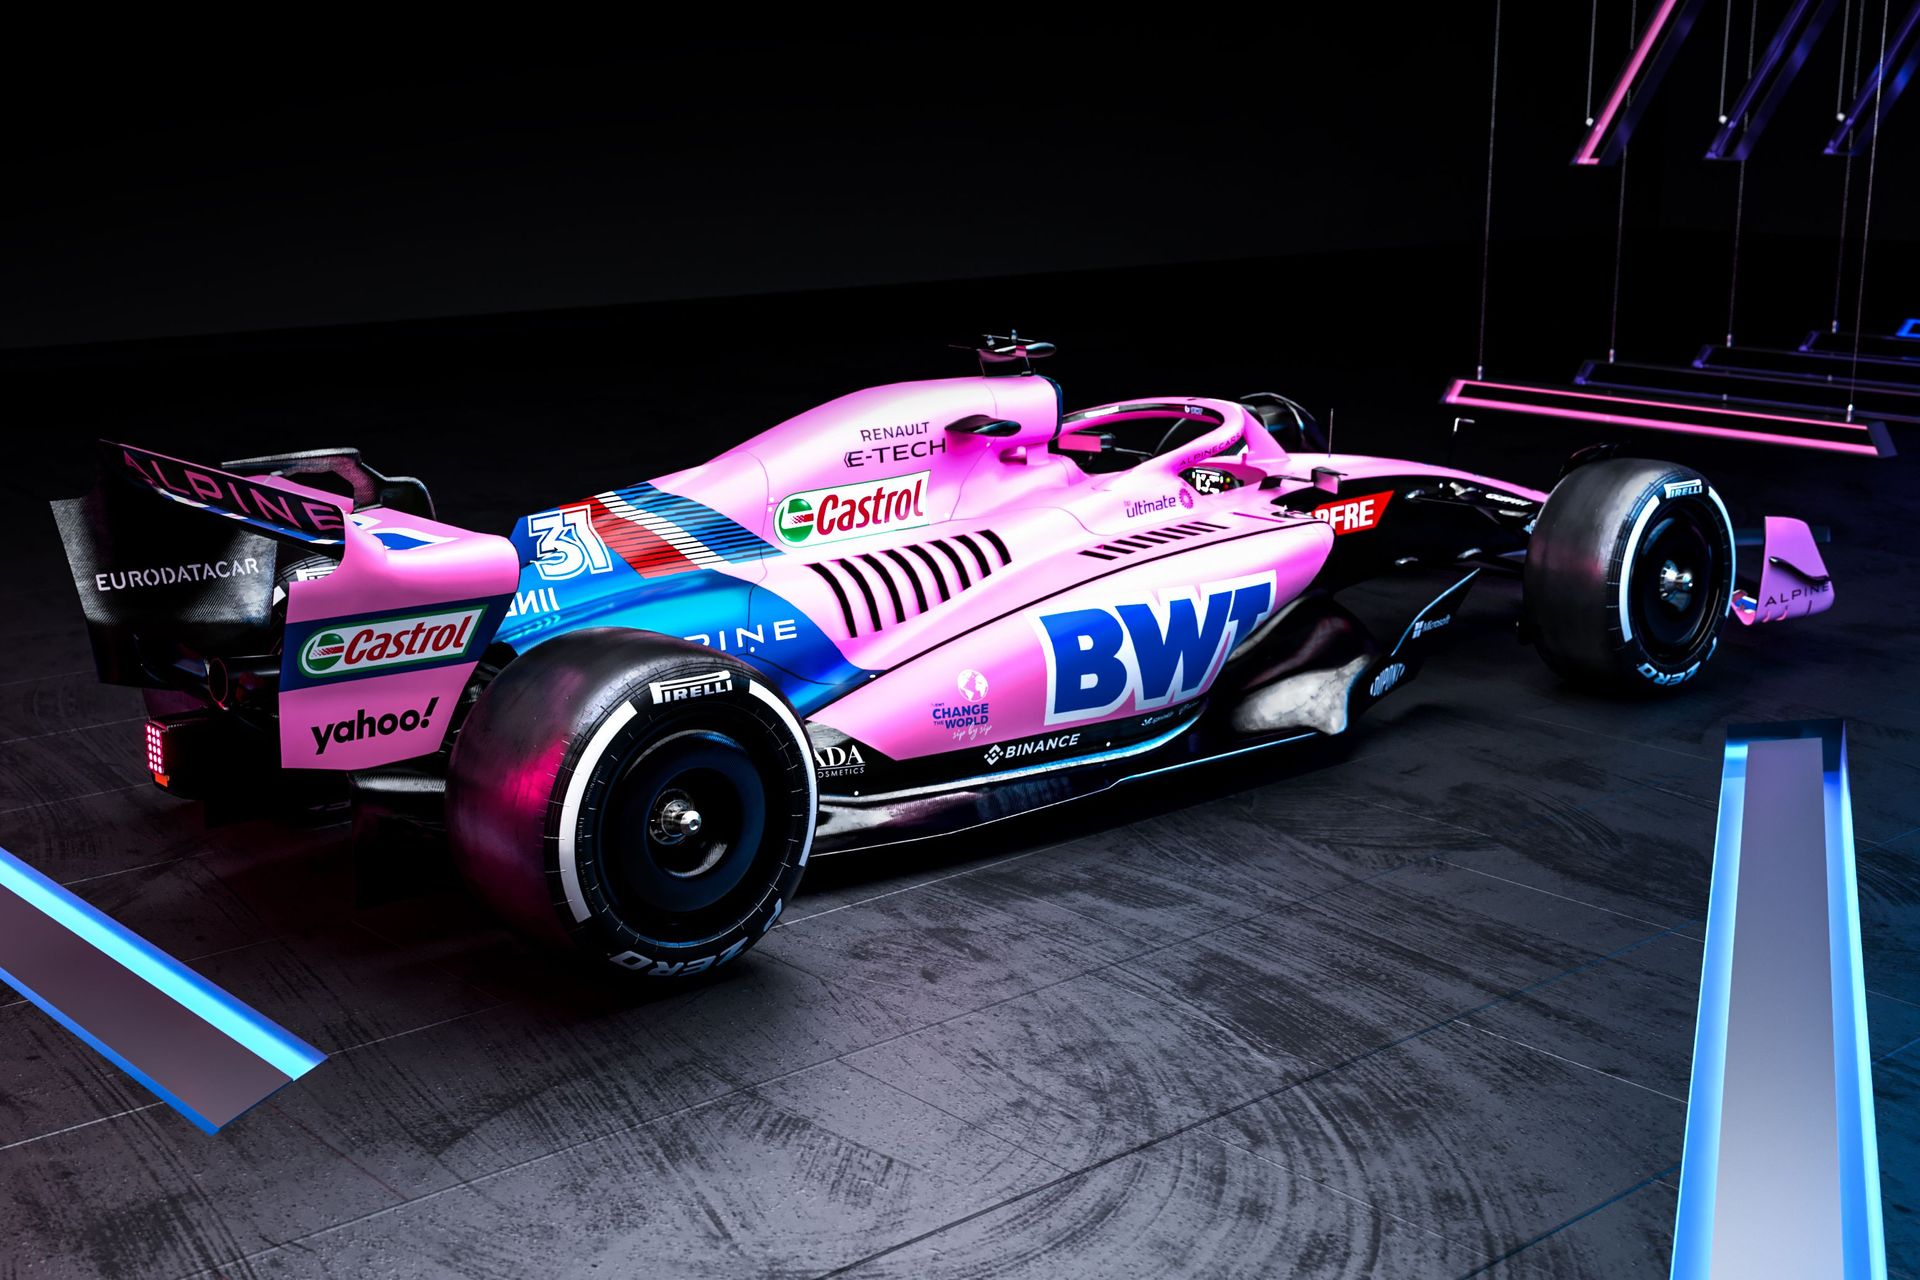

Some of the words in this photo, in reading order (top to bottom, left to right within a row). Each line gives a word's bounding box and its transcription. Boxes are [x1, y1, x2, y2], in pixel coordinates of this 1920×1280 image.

[860, 421, 931, 443] RENAULT
[844, 437, 947, 468] E-TECH
[123, 450, 345, 531] ALPINE
[1663, 479, 1703, 499] PIRELLI
[816, 478, 924, 536] Castrol
[1126, 495, 1177, 518] ultimate
[1314, 499, 1375, 531] PFRE
[528, 504, 614, 581] 31
[95, 558, 259, 592] EURODATACAR
[1764, 584, 1830, 608] ALPINE
[343, 614, 474, 666] Castrol
[1037, 581, 1273, 715] BWT
[648, 669, 733, 705] PIRELLI
[1637, 660, 1701, 687] ZERO
[311, 696, 439, 755] yahoo!
[932, 703, 989, 720] CHANGE
[945, 715, 989, 729] WORLD
[813, 744, 866, 768] ADA
[1005, 733, 1081, 759] BINANCE
[817, 767, 865, 779] OSMETICS
[609, 936, 749, 977] ZERO
